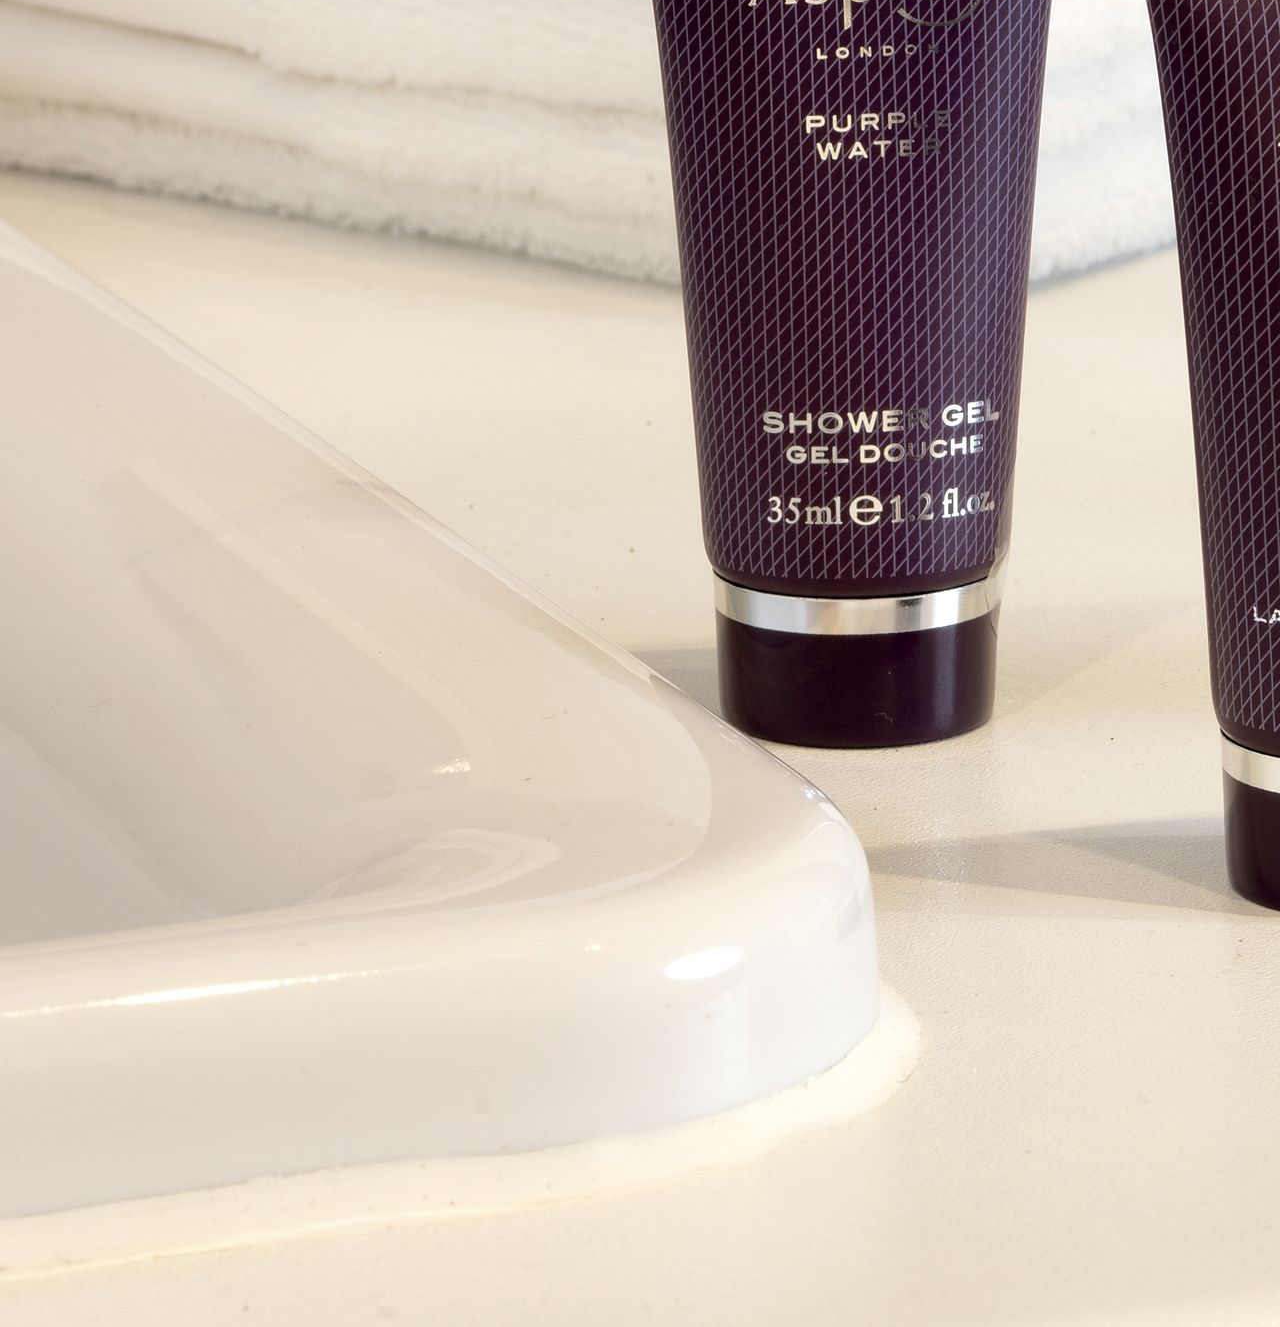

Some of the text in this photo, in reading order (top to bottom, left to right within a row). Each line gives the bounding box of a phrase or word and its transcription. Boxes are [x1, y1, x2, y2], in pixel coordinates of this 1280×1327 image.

[816, 44, 939, 60] LONDON
[805, 110, 951, 134] PURPLE
[816, 138, 941, 160] WATER
[762, 399, 999, 434] SHOWER GEL
[786, 434, 984, 464] GEL DOUCHE
